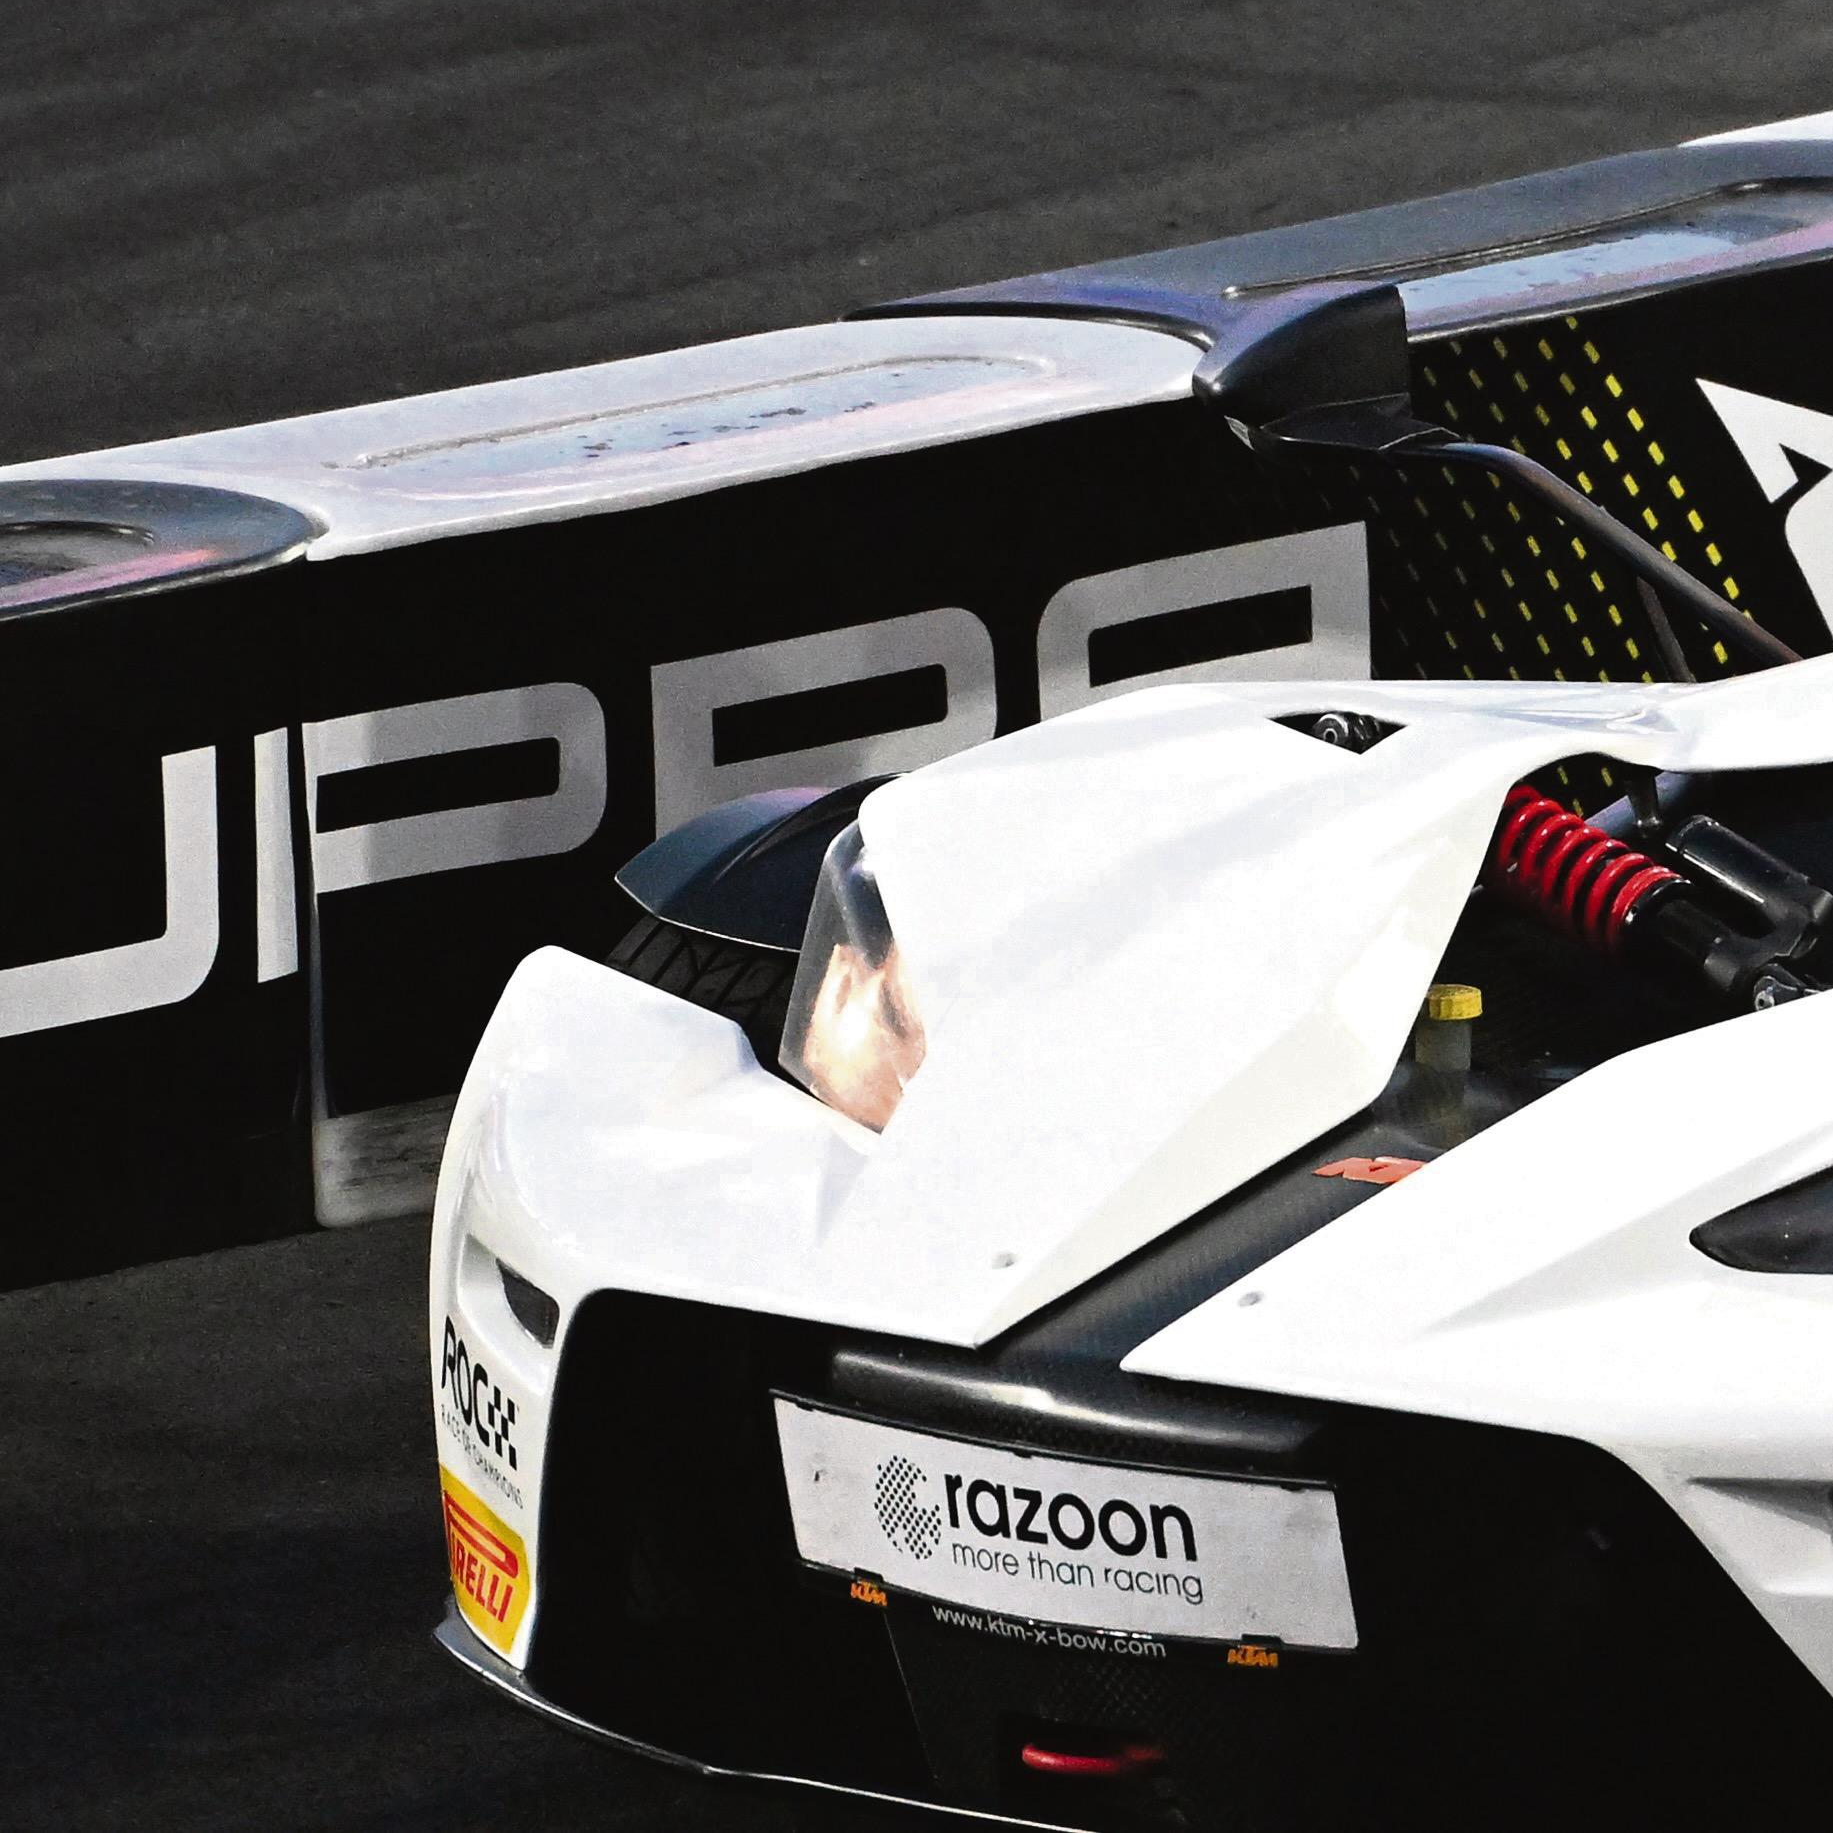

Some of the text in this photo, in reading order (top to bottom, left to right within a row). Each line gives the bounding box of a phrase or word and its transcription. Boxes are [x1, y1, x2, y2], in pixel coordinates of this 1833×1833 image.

[441, 1315, 490, 1447] ROC
[944, 1472, 1198, 1562] razoon
[951, 1540, 1204, 1606] more than racing
[932, 1604, 1167, 1659] www.ktm-x-bow.com
